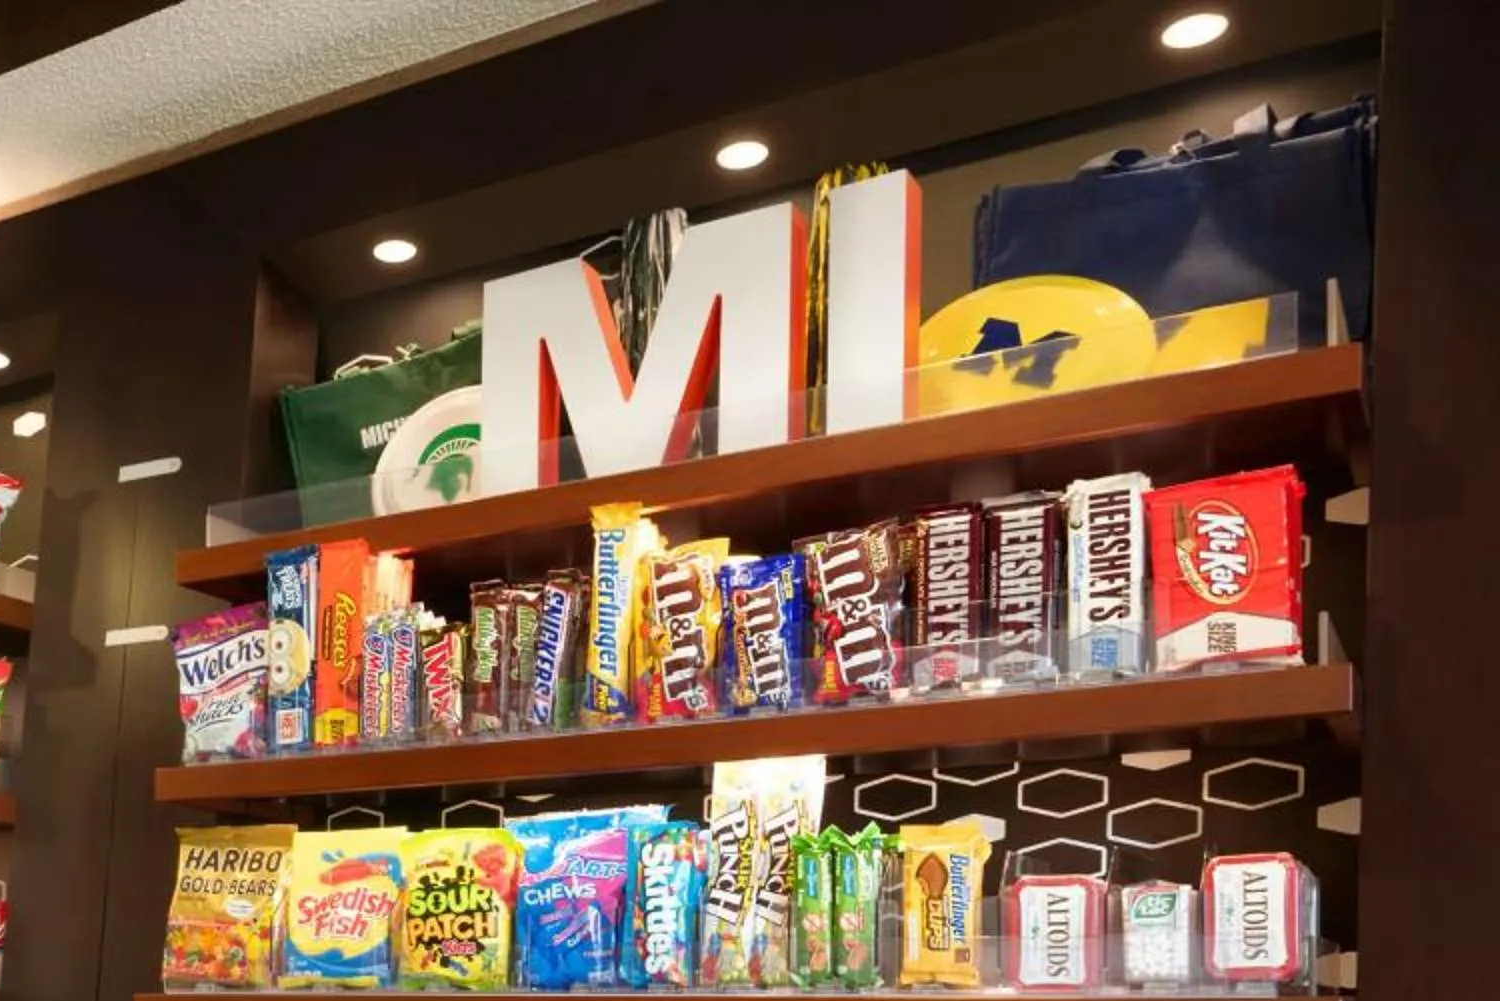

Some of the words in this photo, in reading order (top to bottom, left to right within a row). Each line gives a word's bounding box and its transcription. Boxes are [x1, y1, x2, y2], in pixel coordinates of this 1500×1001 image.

[928, 514, 971, 645] HERSHEY'S
[1000, 506, 1046, 646] HERSHEY'S
[1088, 489, 1131, 623] HERSHEY'S
[534, 591, 566, 698] SNICKERS
[594, 528, 625, 676] Butterfinger
[1207, 621, 1222, 653] SIZE
[1223, 621, 1237, 653] KING
[180, 635, 265, 687] Welch's
[185, 847, 283, 873] HARIBO
[408, 883, 492, 917] SOUR
[523, 882, 597, 906] CHEWS
[707, 802, 749, 925] PUNCH
[754, 802, 799, 925] PUNCH
[950, 854, 971, 945] Butterfinger
[298, 887, 397, 924] Swedish
[313, 911, 369, 938] Fish
[406, 911, 498, 946] PATCH
[642, 843, 682, 975] Skittles
[1046, 892, 1070, 977] ALTOIDS
[1242, 870, 1269, 961] ALTOIDS
